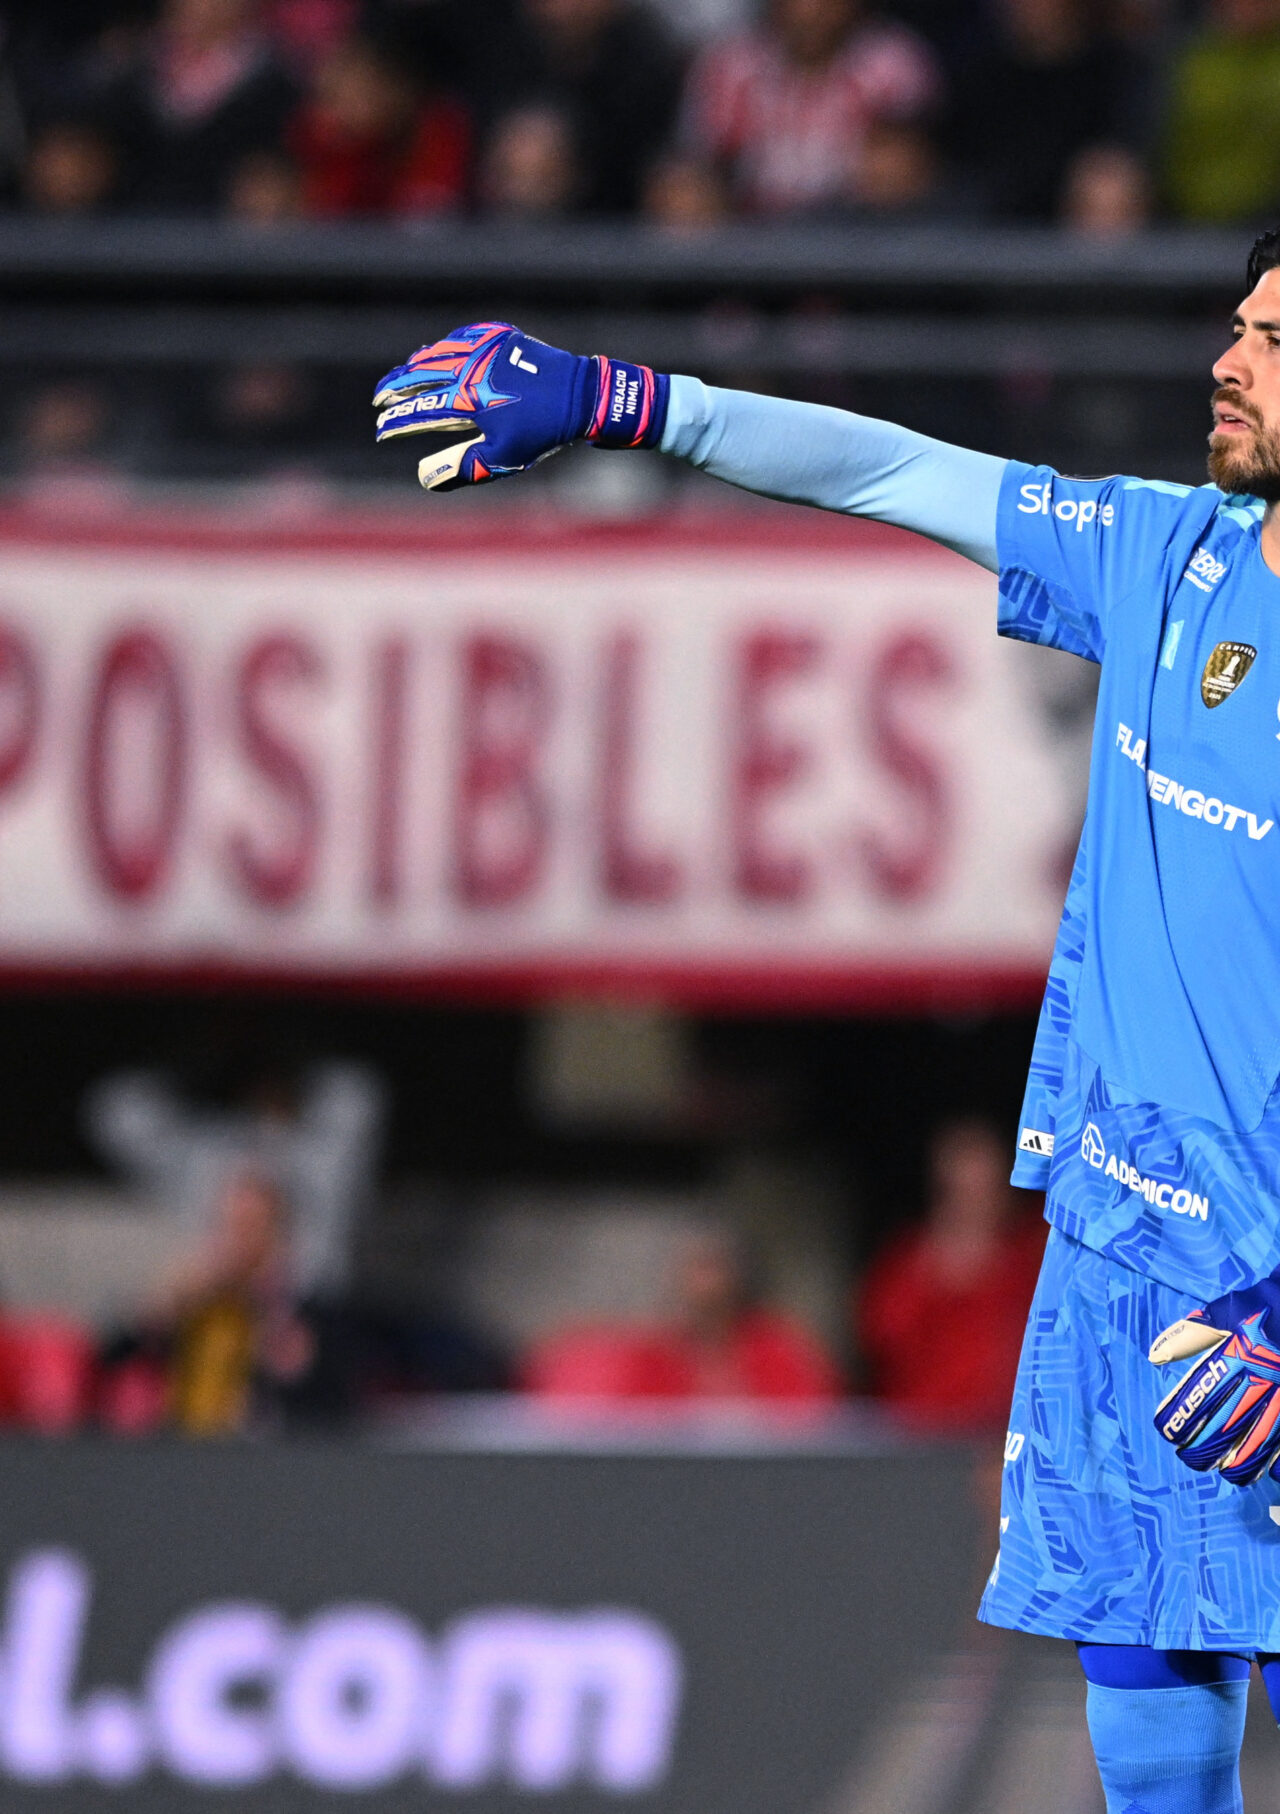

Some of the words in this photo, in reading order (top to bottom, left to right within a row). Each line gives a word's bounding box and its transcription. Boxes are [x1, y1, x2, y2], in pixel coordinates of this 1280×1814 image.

[611, 369, 627, 422] HORACIO
[625, 381, 639, 415] NIMIA
[1017, 483, 1114, 532] Shope
[1104, 1154, 1209, 1222] ADEMICON
[1163, 1359, 1229, 1440] reusch
